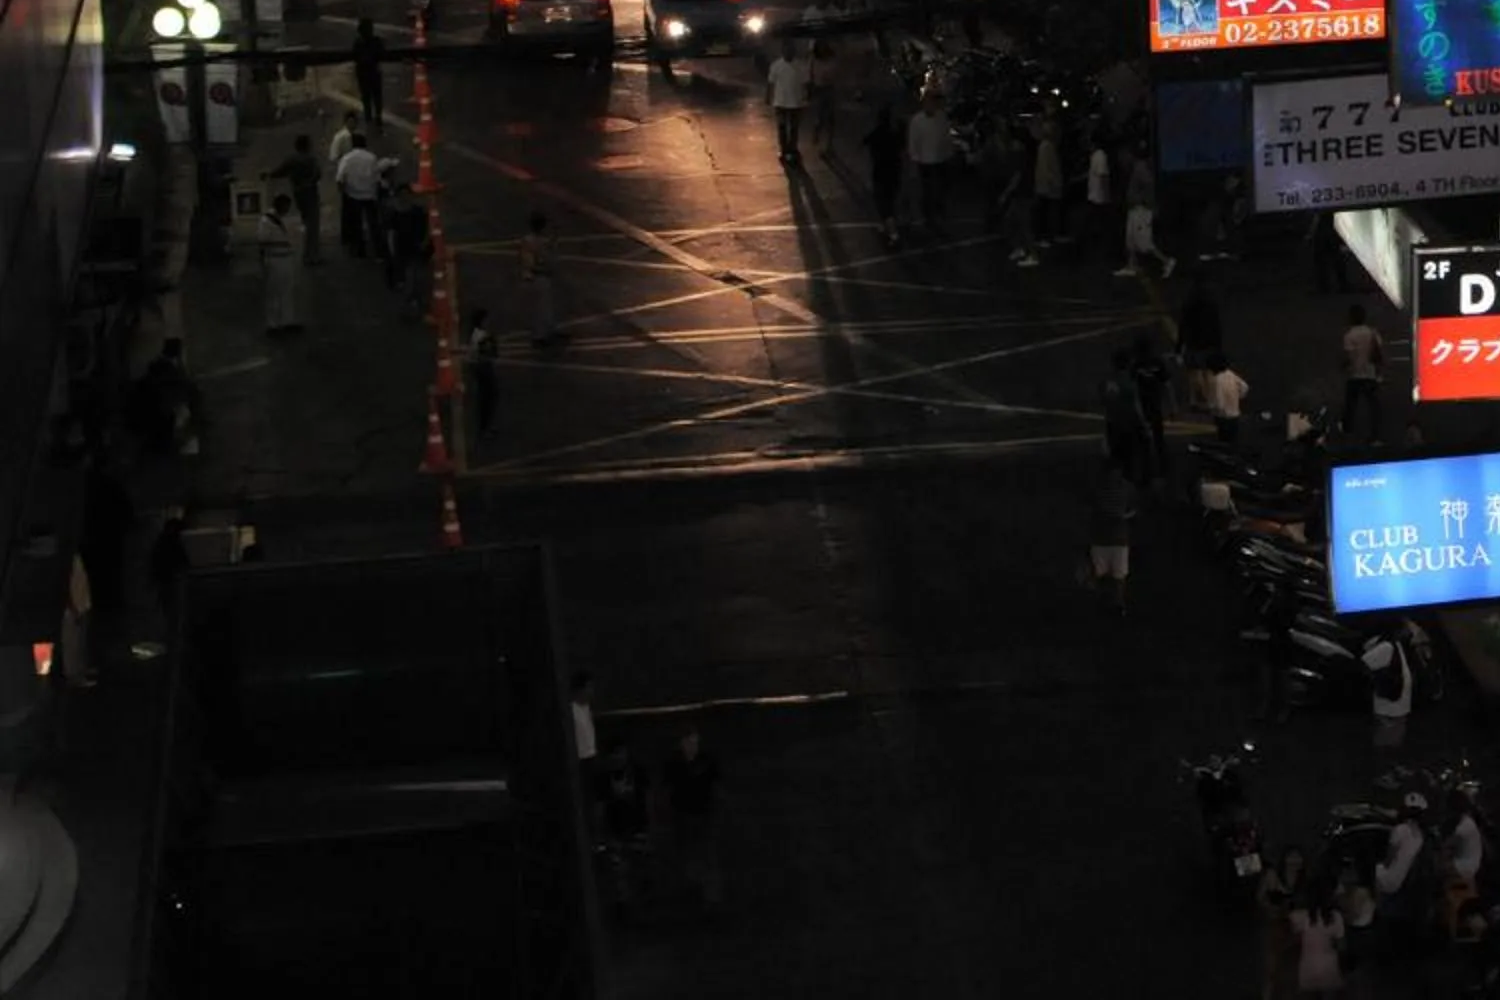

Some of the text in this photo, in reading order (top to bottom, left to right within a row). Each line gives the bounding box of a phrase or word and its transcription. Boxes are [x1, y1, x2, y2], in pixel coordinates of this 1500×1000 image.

[1225, 13, 1380, 44] 02-2375618
[1277, 133, 1384, 165] THREE
[1397, 124, 1500, 155] SEVEN
[1423, 261, 1450, 280] 2F
[1350, 524, 1419, 550] CLUB
[1354, 543, 1494, 578] KAGURA
